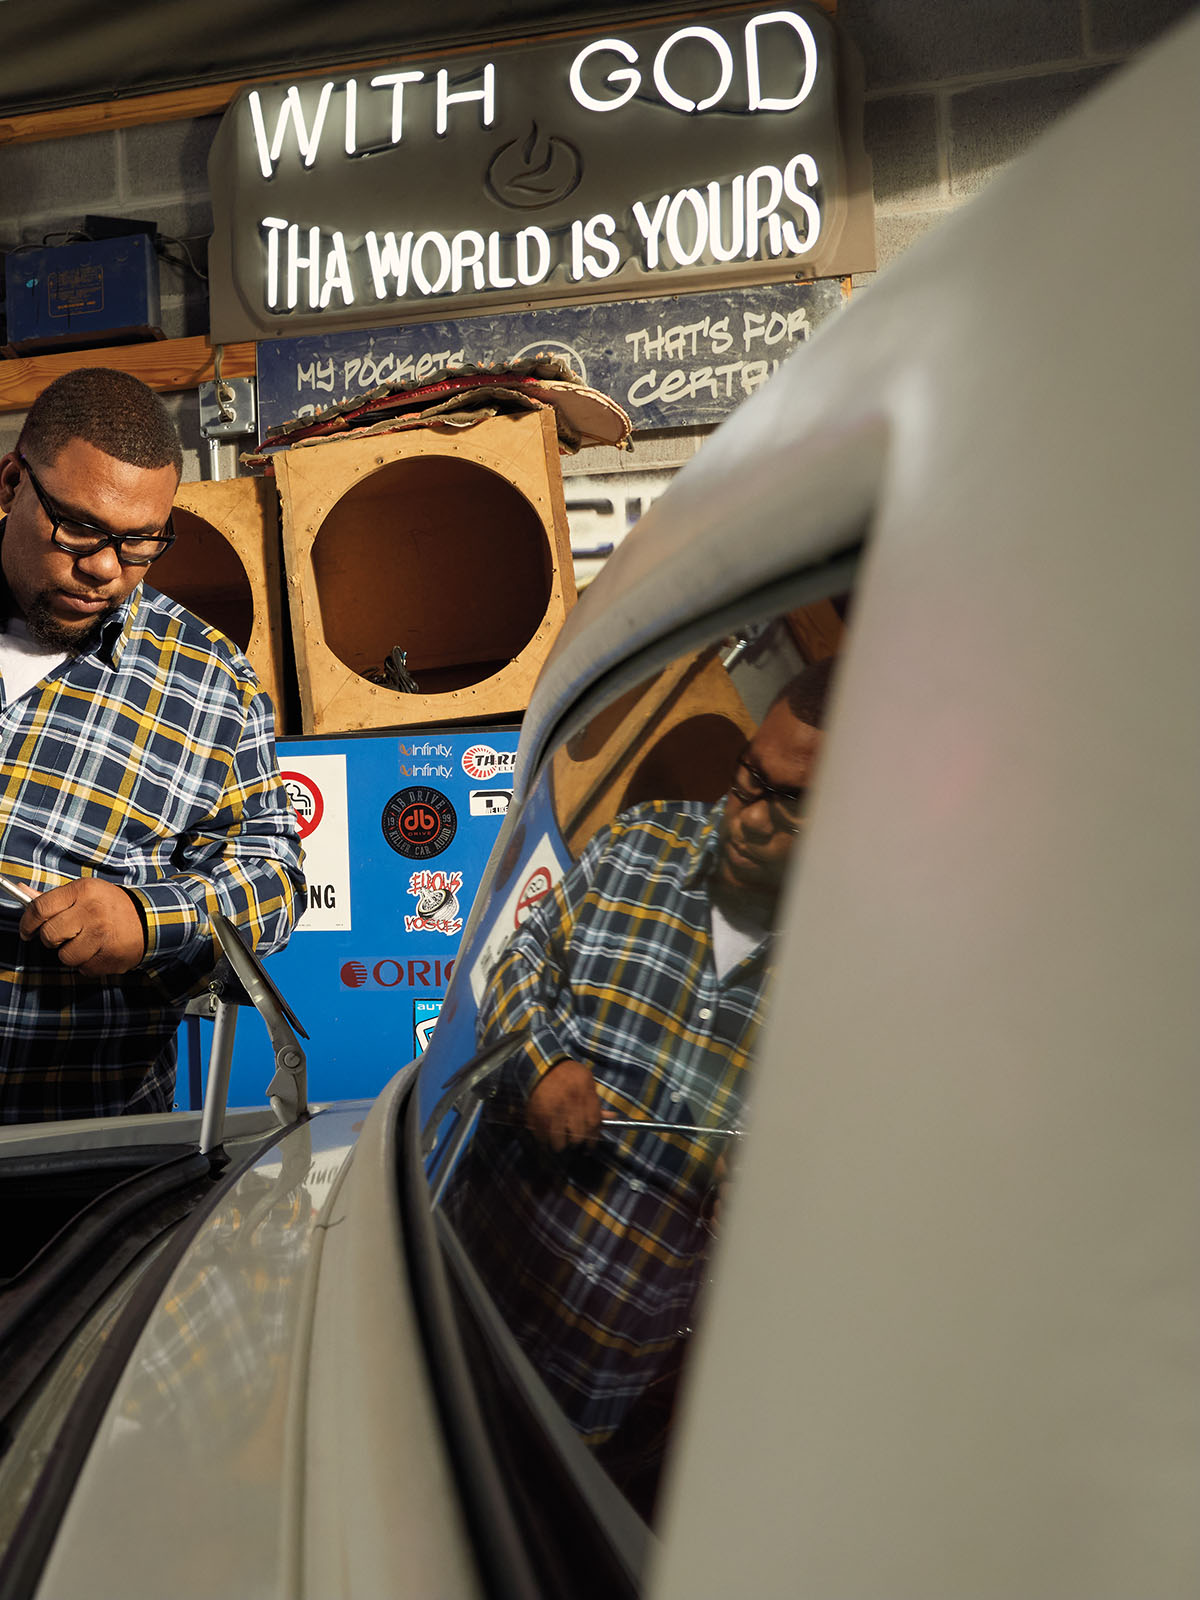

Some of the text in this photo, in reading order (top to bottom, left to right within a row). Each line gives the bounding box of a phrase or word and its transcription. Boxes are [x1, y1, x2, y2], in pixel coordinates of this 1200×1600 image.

[249, 11, 818, 178] WITH GOD
[262, 153, 821, 309] THA WORLD IS YOURS
[625, 307, 810, 363] THAT'S FOR
[297, 356, 335, 392] MY
[390, 790, 446, 812] DB DRIVE
[404, 809, 435, 831] db
[389, 828, 451, 856] KILLER CAR AUDIO
